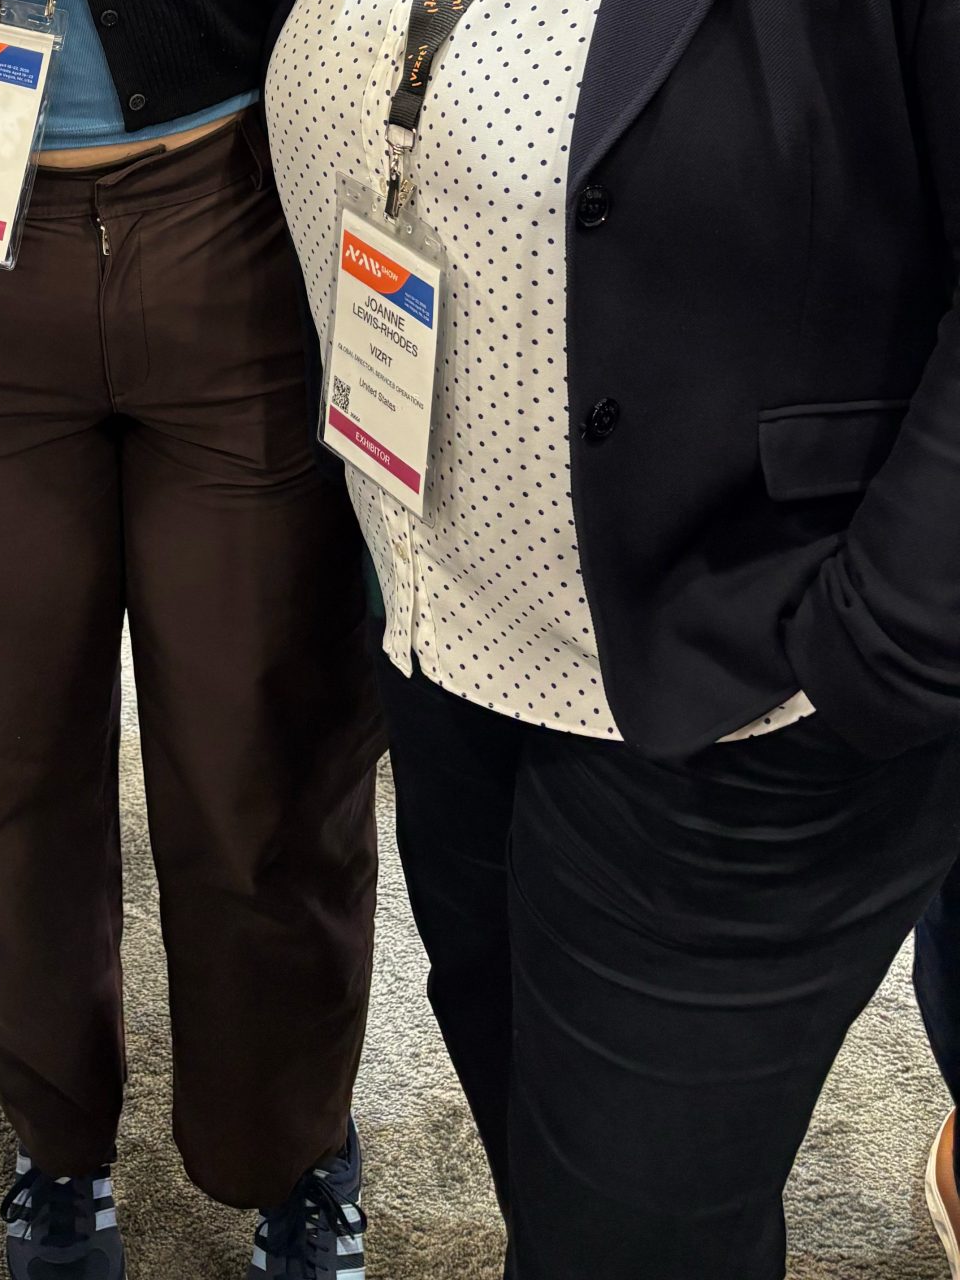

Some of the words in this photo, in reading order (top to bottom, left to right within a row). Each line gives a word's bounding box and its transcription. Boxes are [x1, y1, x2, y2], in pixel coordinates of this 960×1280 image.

[345, 244, 382, 277] NAB
[381, 265, 398, 281] SHOW
[352, 302, 418, 357] LEWIS-RHODES
[365, 296, 405, 332] JOANNE
[369, 343, 393, 368] VIZRT
[359, 377, 377, 398] United
[378, 391, 396, 412] States
[355, 431, 391, 465] EXHIBITOR
